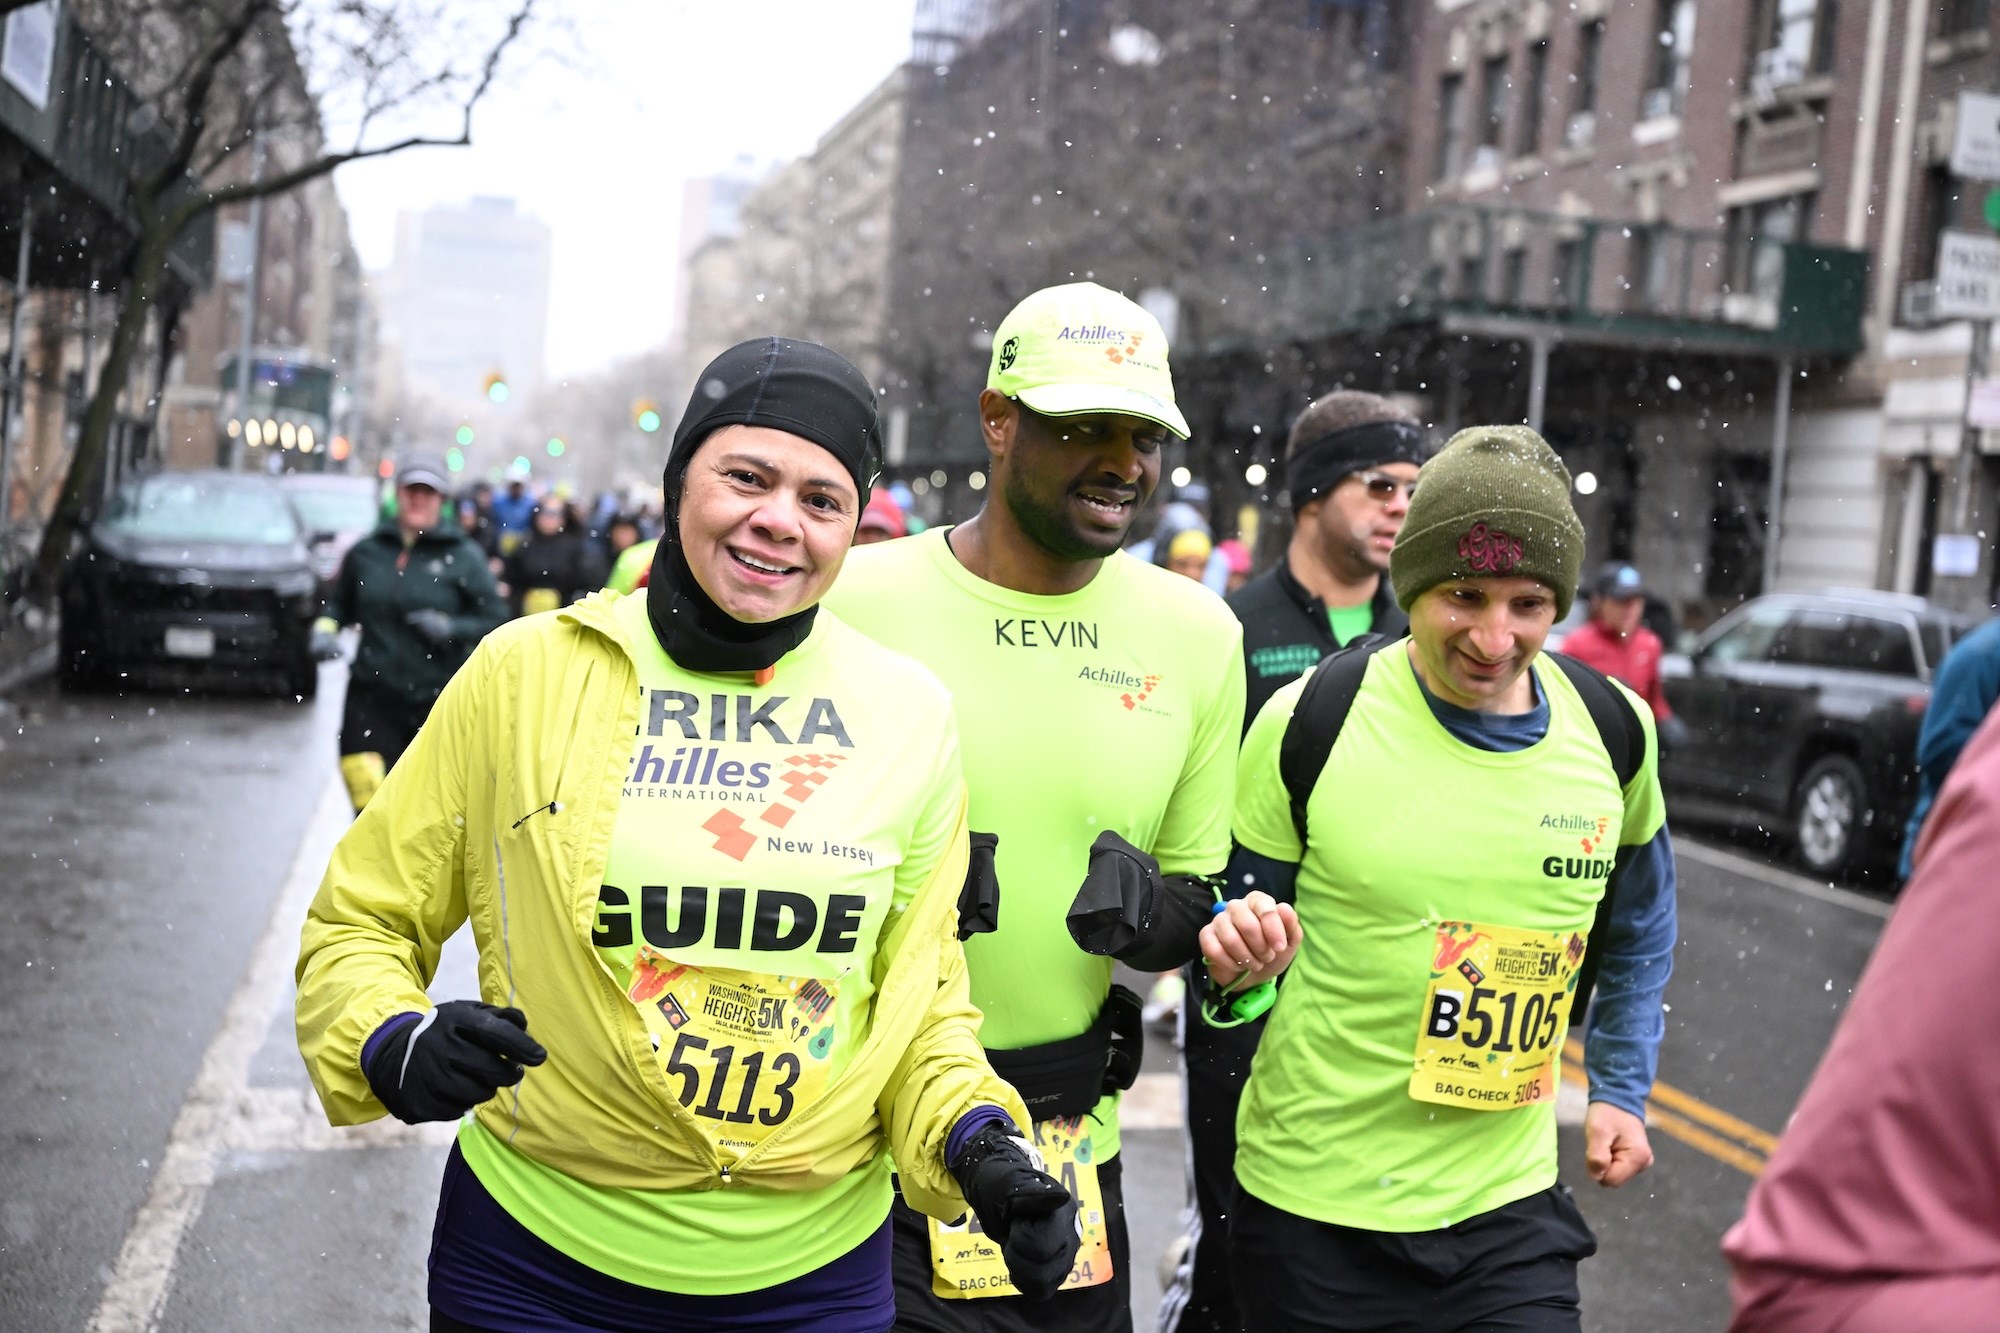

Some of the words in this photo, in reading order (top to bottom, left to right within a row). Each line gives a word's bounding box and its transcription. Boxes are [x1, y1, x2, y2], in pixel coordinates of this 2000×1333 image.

[1057, 325, 1125, 341] Achilles
[995, 618, 1098, 650] KEVIN
[1078, 666, 1141, 688] Achilles
[635, 686, 855, 748] RIKA
[625, 745, 771, 789] hilles
[622, 788, 766, 803] NTERNATIONAL
[1540, 814, 1596, 831] Achilles
[767, 837, 813, 853] New
[822, 841, 873, 866] Jersey
[1542, 856, 1612, 879] GUIDE
[592, 884, 866, 954] GUIDE
[1494, 957, 1538, 976] HEIGHTS
[1538, 952, 1563, 977] 5K
[1497, 947, 1540, 960] WASHINGTON
[709, 983, 759, 1009] WASHINGTON
[702, 996, 757, 1027] HEIGHTS
[757, 997, 787, 1029] 5K
[1435, 1082, 1464, 1097] BAG
[1468, 1088, 1511, 1102] CHECK
[1514, 1079, 1541, 1105] 5105
[959, 1276, 987, 1291] BAG
[1069, 1260, 1094, 1283] 54
